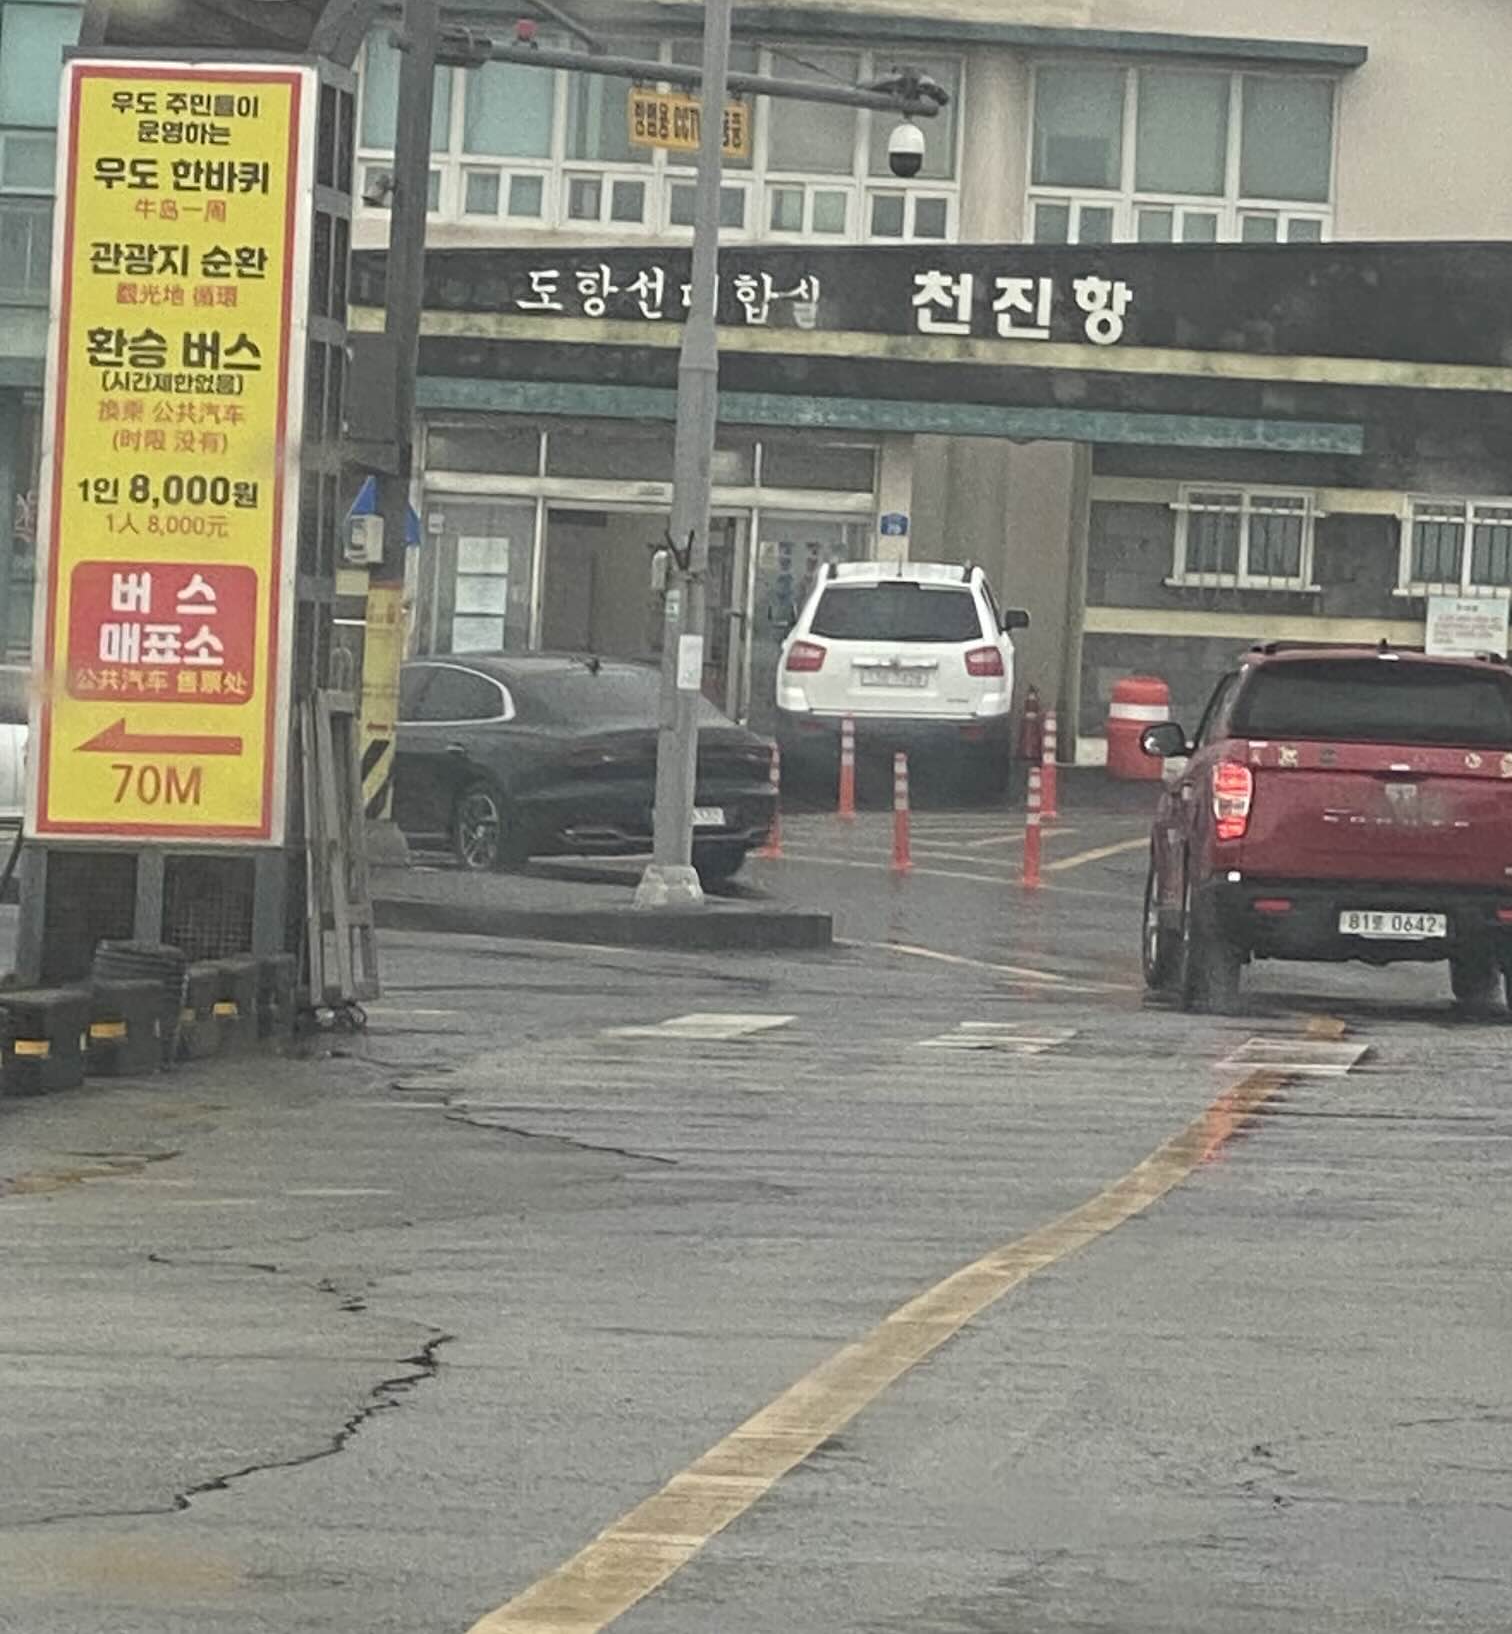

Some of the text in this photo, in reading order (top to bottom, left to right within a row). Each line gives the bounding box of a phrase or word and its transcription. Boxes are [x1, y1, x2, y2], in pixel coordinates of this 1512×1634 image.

[111, 91, 259, 118] 우도 주민들이
[138, 121, 231, 146] 운영하는
[94, 157, 270, 194] 우도 한바퀴
[89, 242, 268, 279] 관광지 순환
[912, 270, 1133, 345] 천진항
[86, 326, 261, 371] 환승 버스
[78, 474, 258, 509] 1인 8,000원
[106, 515, 229, 538] 1人 8,000元
[99, 622, 224, 666] 매표소
[111, 764, 201, 806] 70M
[1391, 915, 1437, 933] 0642
